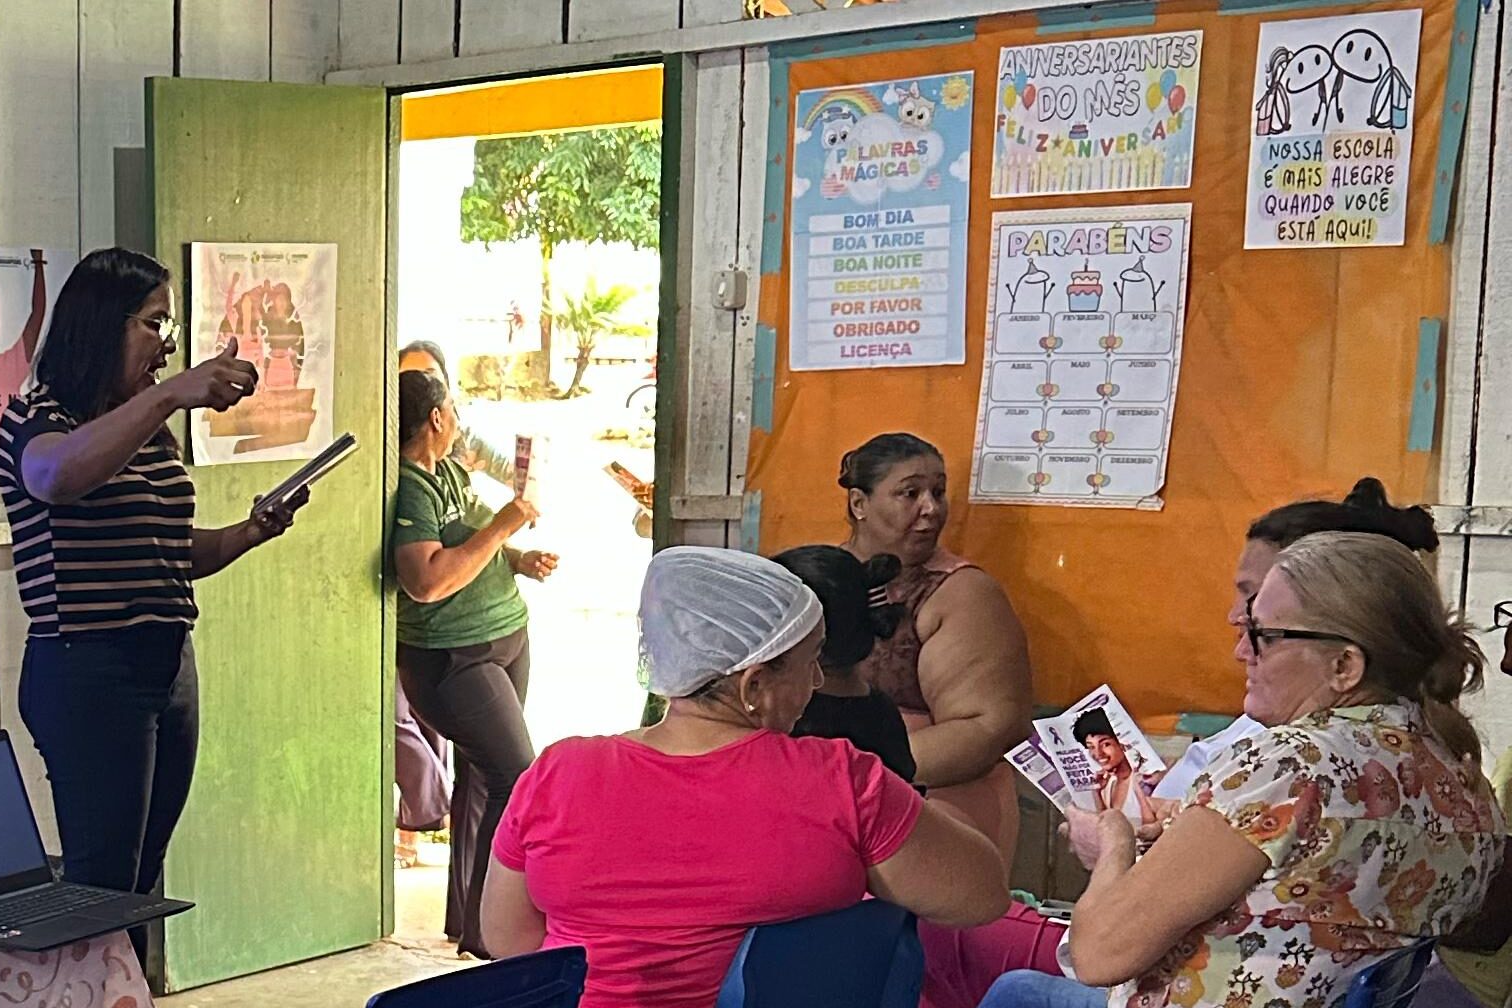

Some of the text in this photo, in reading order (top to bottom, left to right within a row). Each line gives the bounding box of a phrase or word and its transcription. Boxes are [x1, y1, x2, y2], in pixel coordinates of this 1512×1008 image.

[1000, 35, 1198, 80] ANIVERSARIANTES
[1038, 73, 1141, 123] DO MÊS
[997, 114, 1049, 153] FELIZ
[837, 139, 928, 164] PALAVRAS
[1268, 136, 1394, 162] NOSSA ESCOLA
[840, 159, 921, 182] MÁGICAS
[1264, 164, 1278, 188] É
[1331, 165, 1395, 189] ALEGRE
[1345, 187, 1390, 212] VOCÊ
[843, 210, 914, 229] BOM DIA
[1277, 215, 1321, 241] ESTÁ
[832, 232, 925, 251] BOA TARDE
[1008, 222, 1173, 257] PARABÉNS
[833, 253, 923, 272] BOA NOITE
[834, 276, 921, 293] DESCULPA
[830, 298, 922, 316] POR FAVOR
[833, 320, 920, 338] OBRIGADO
[840, 343, 912, 359] LICENÇA
[1066, 769, 1094, 778] FEITA
[1070, 776, 1098, 786] PARA
